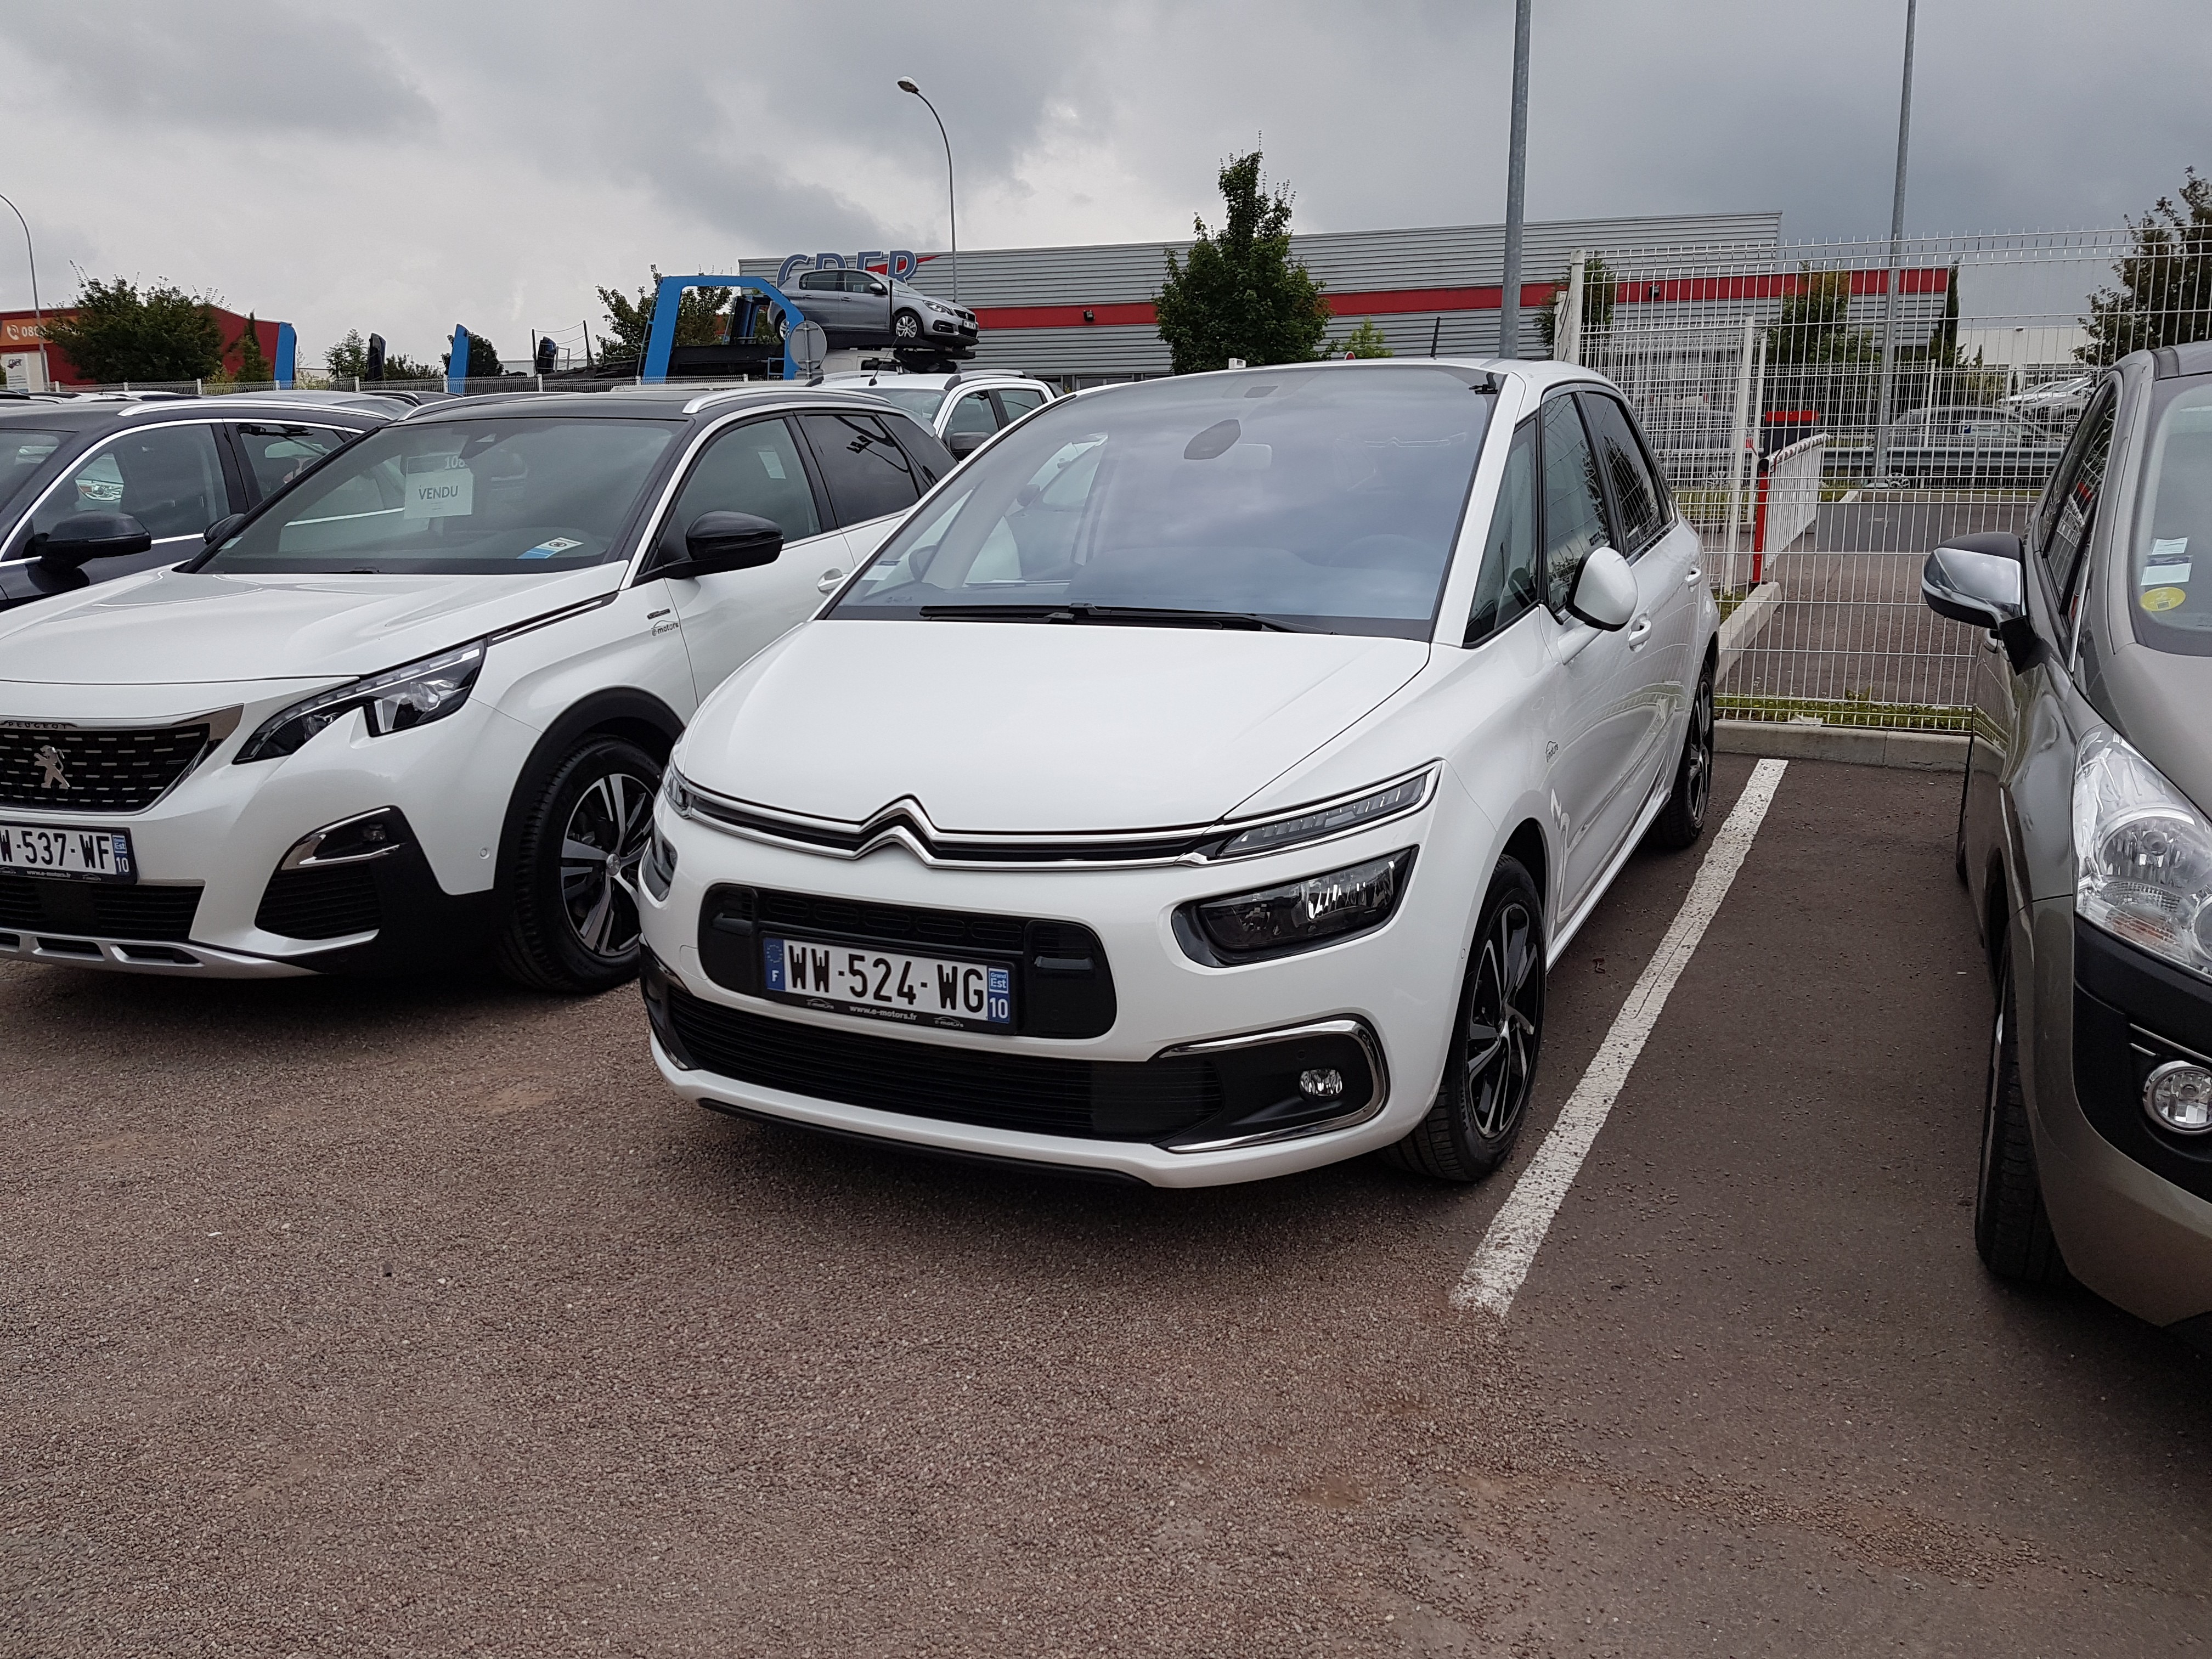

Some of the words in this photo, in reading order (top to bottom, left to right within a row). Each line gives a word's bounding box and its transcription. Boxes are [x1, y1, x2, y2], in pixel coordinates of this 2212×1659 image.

[419, 486, 459, 500] VENDU
[116, 856, 129, 873] 10
[771, 970, 779, 982] F
[788, 945, 984, 1013] WW-524-WG
[990, 978, 1007, 989] Est
[849, 1006, 917, 1021] www.e-motors.fr
[990, 997, 1008, 1019] 10
